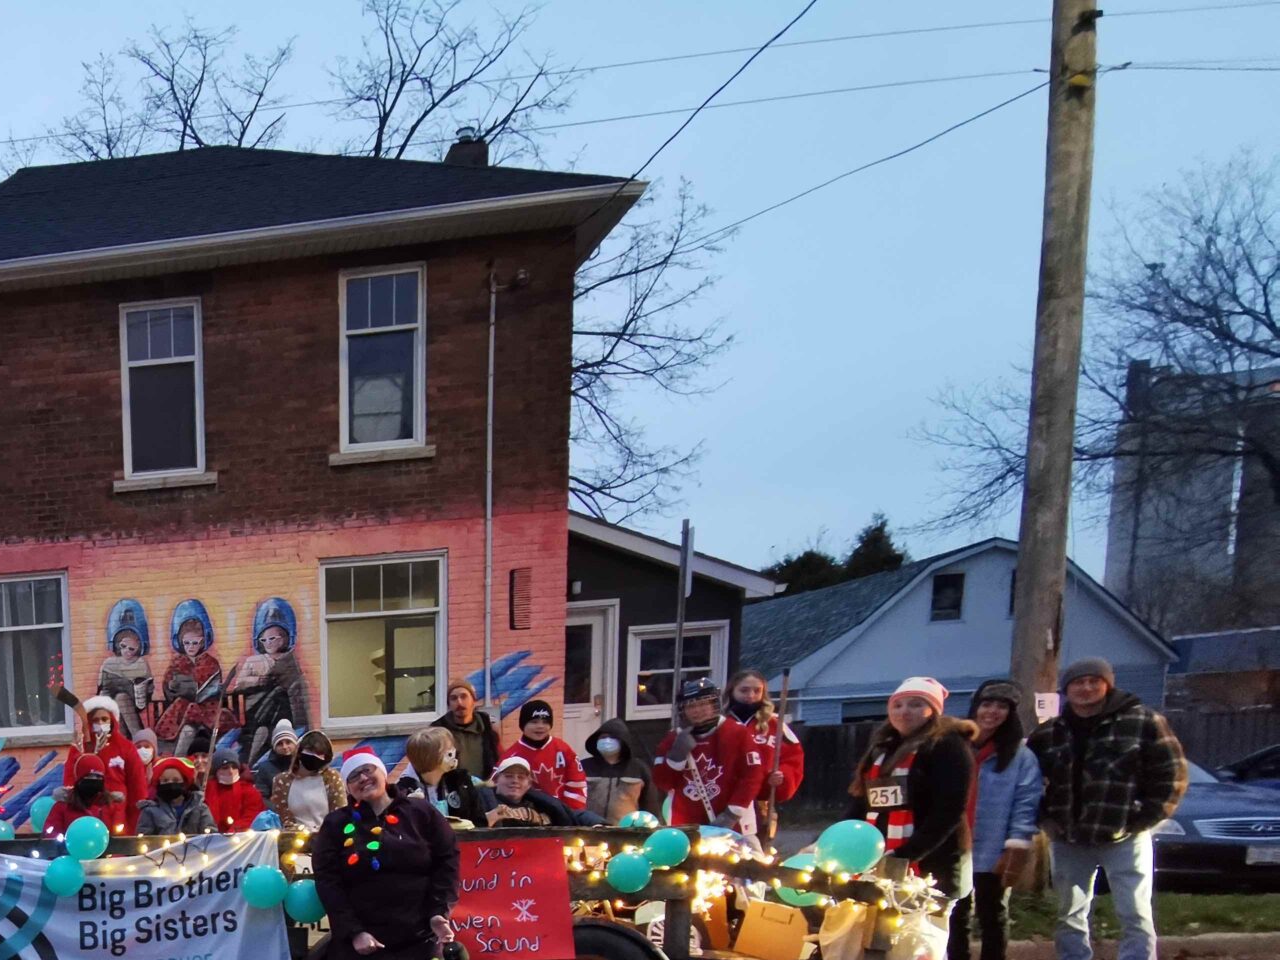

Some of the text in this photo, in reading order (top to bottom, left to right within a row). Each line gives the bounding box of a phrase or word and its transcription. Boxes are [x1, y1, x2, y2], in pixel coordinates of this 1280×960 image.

[555, 751, 566, 768] A
[870, 788, 899, 805] 251
[462, 871, 531, 891] und in
[78, 882, 126, 919] Big
[79, 909, 238, 957] Big Sisters
[452, 914, 500, 932] wen
[476, 931, 540, 953] Sound
